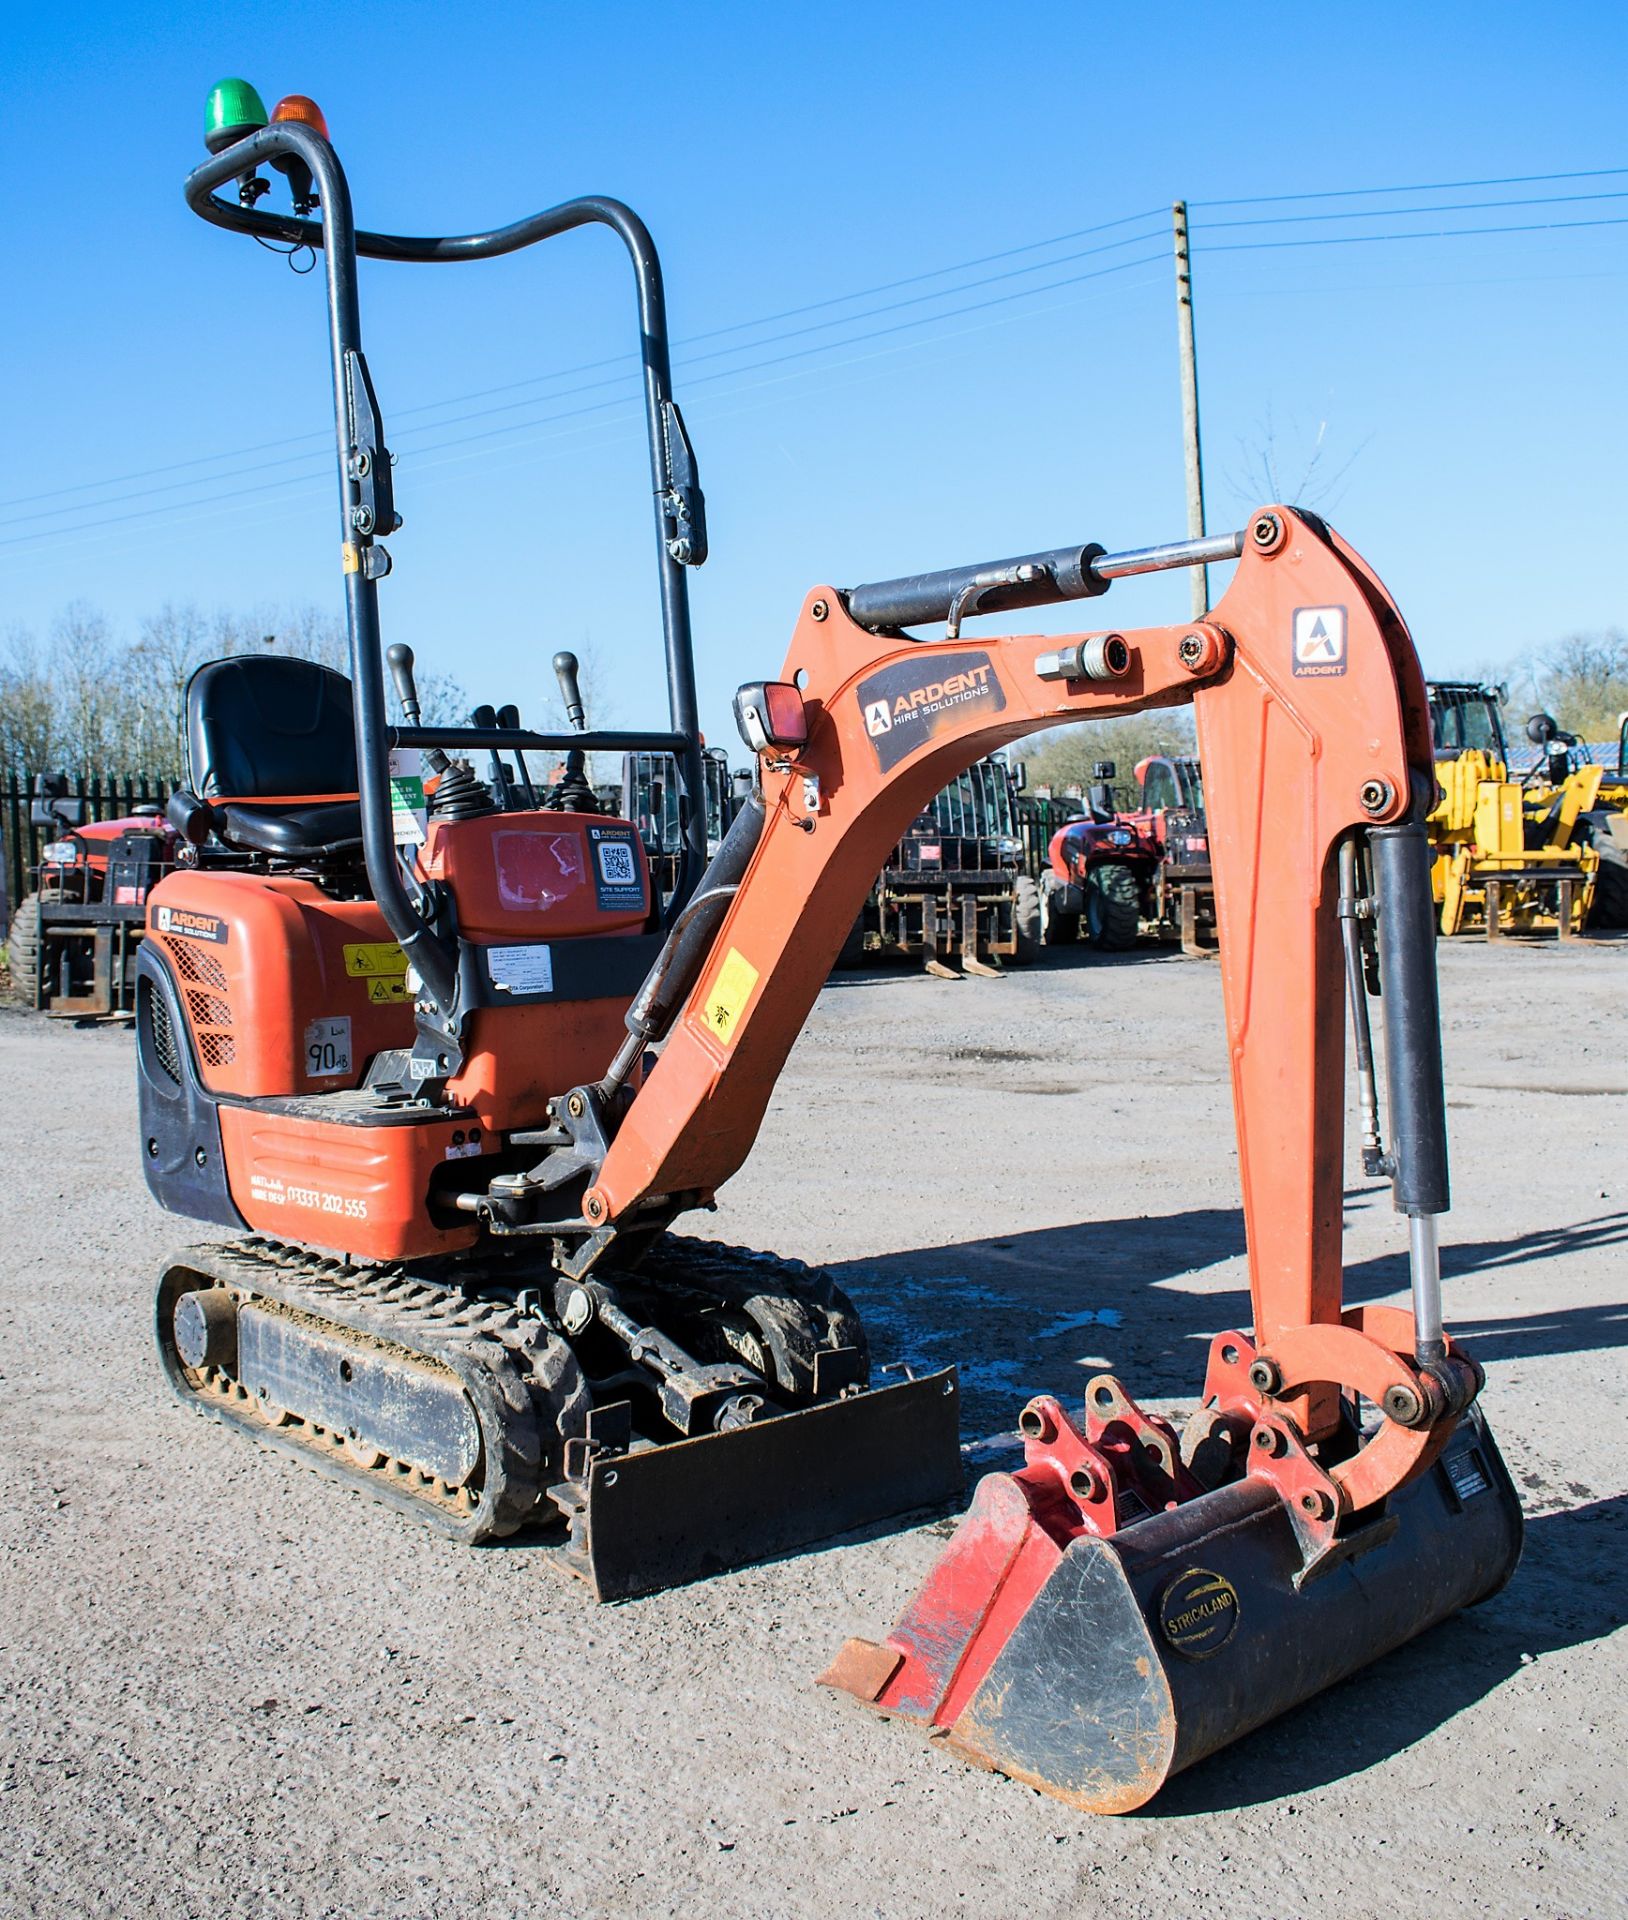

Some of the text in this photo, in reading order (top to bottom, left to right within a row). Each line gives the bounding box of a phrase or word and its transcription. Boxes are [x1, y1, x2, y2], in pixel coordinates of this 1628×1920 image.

[1295, 665, 1344, 675] ARDENT
[893, 664, 990, 716] ARDENT
[893, 684, 989, 726] HIRE SOLUTIONS
[171, 911, 220, 932] ARDENT
[184, 927, 217, 940] SOLUTIONS
[309, 1042, 336, 1072] 90
[321, 1193, 343, 1214] 202
[344, 1199, 368, 1219] 555
[1168, 1592, 1232, 1634] STRICKLAND
